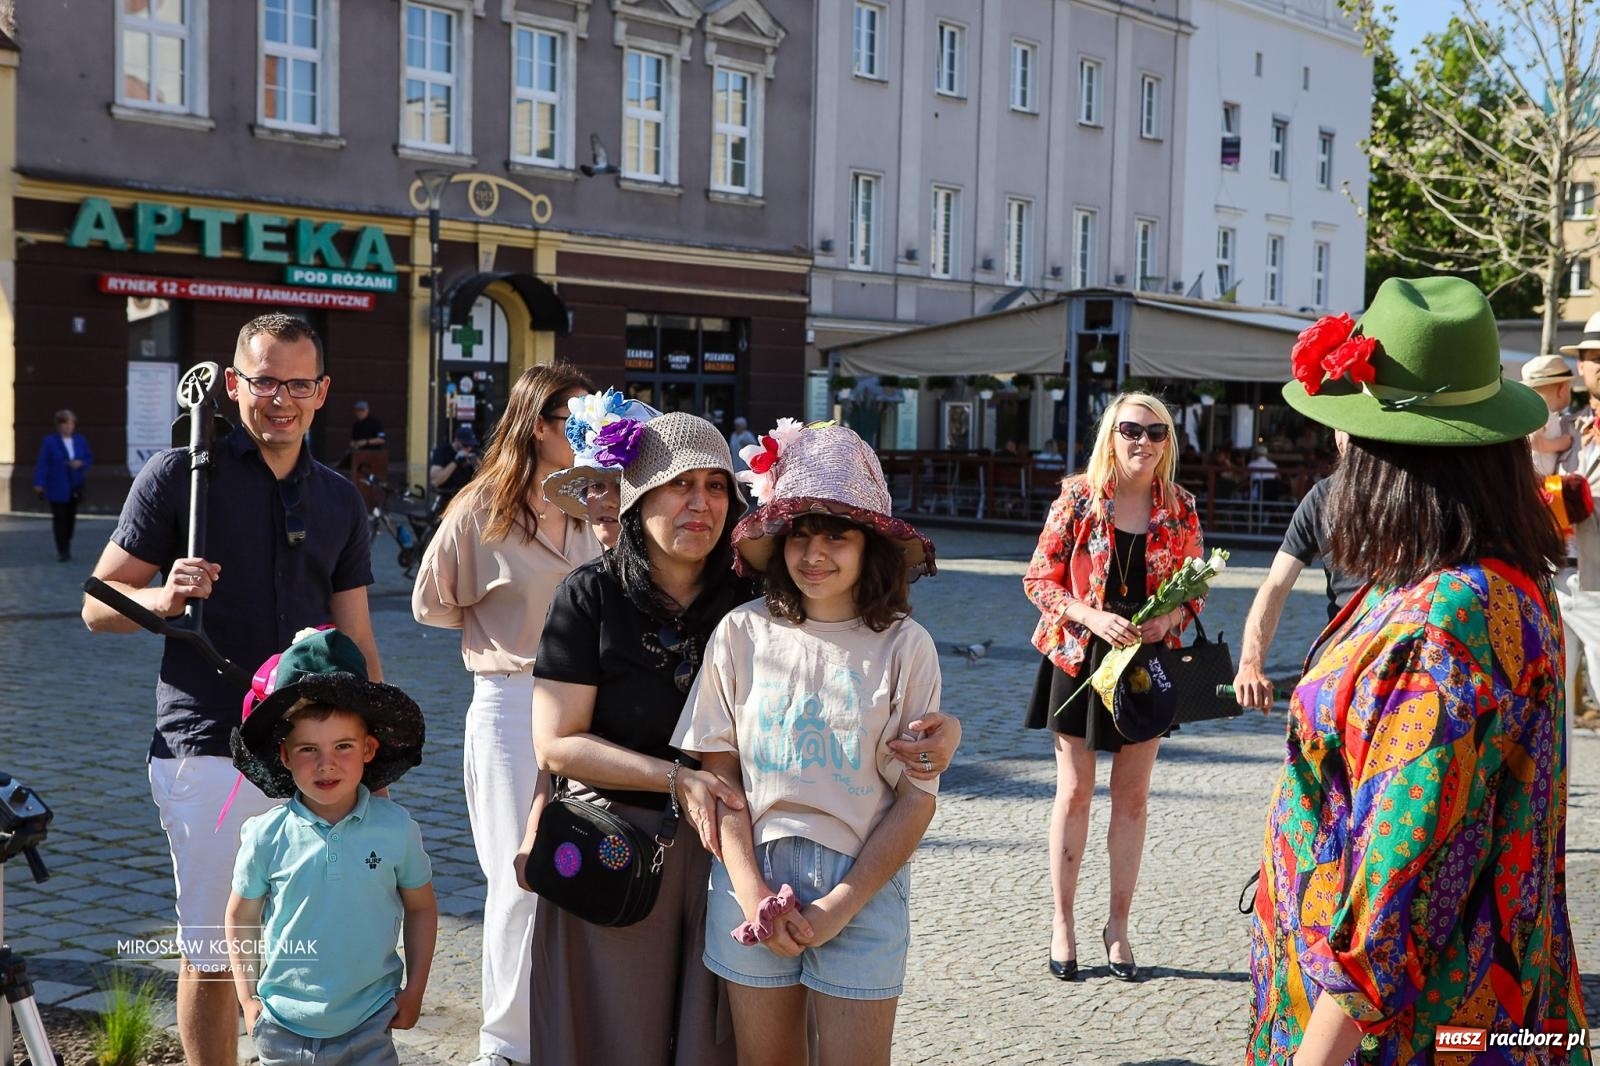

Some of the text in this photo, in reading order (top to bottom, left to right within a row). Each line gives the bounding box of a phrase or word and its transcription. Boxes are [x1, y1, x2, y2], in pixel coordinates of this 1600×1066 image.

[67, 196, 397, 272] APTEKA
[107, 277, 158, 293] RYNEK
[162, 280, 178, 295] 12
[188, 282, 254, 300] CENTRUM
[256, 287, 370, 308] FARMACEUTYCZNE
[294, 270, 392, 289] POD RÓŻAMI
